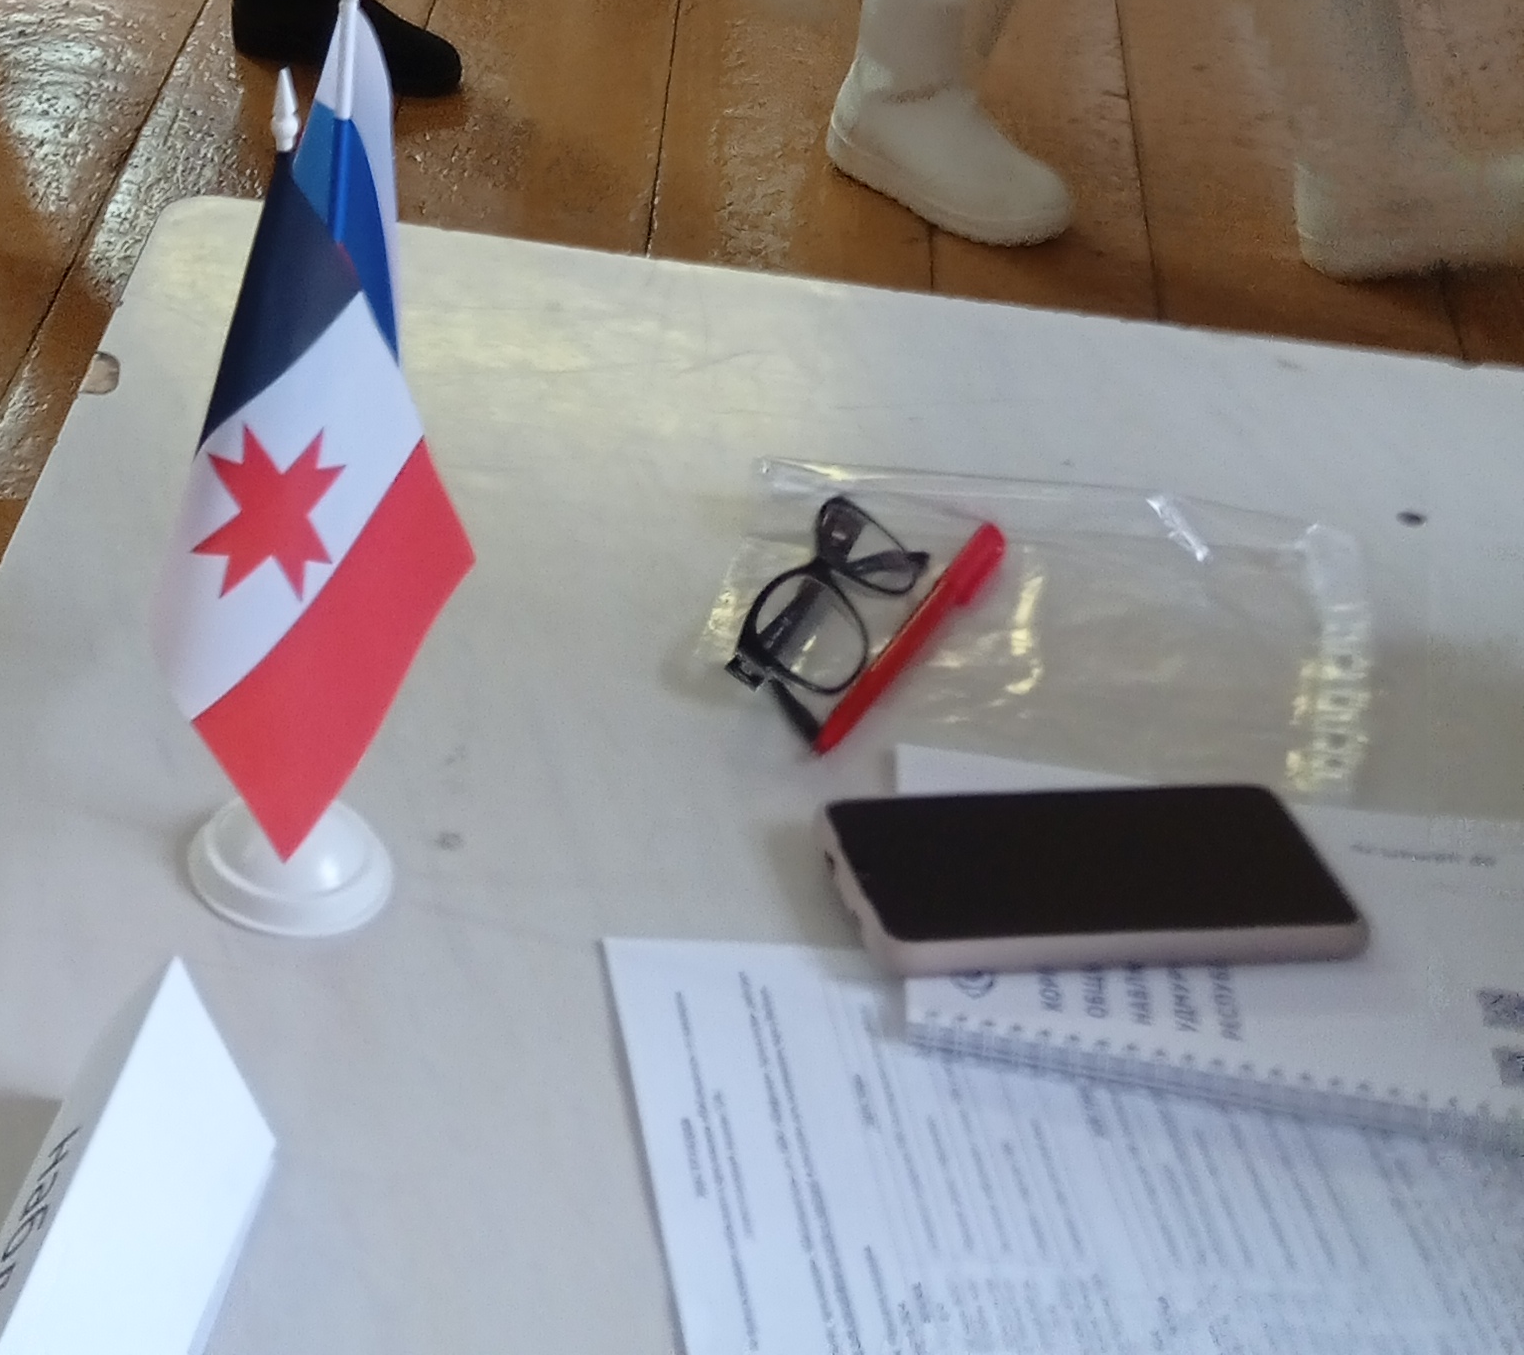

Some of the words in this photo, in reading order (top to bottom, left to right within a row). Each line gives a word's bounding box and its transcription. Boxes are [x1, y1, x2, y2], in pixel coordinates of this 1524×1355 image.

[1082, 965, 1108, 1019] ОБЩ
[1126, 964, 1152, 1026] НАБЛ
[1168, 965, 1199, 1033] УДМУР
[1208, 965, 1244, 1042] РЕСПУБ
